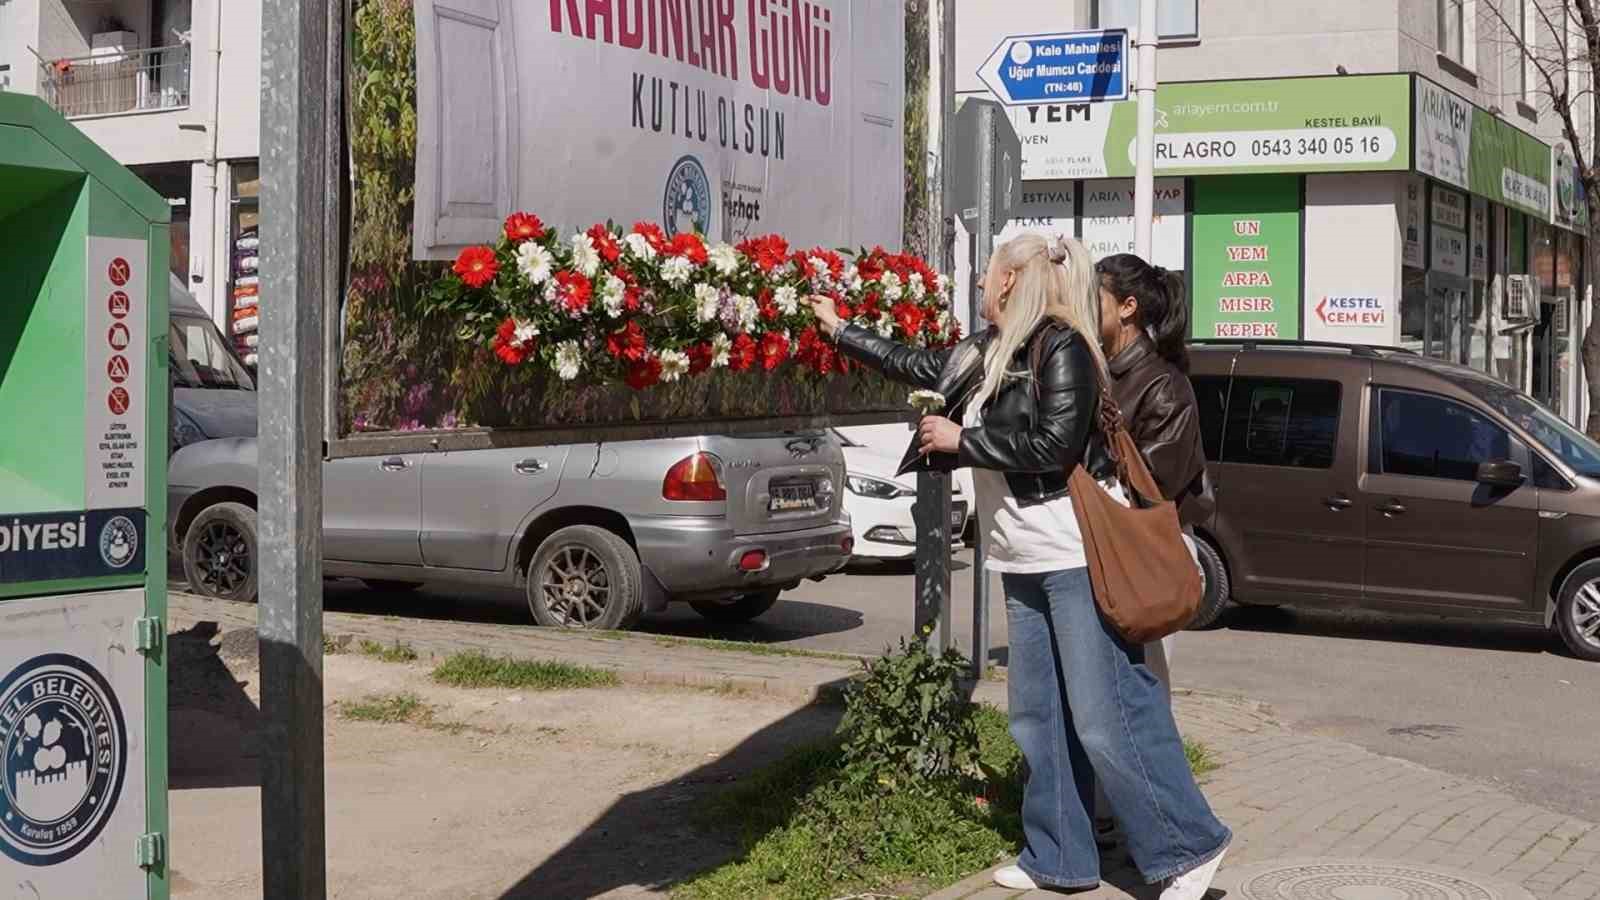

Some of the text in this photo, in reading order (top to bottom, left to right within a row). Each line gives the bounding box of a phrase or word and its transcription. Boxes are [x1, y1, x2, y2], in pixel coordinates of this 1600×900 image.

[748, 0, 831, 106] GÜNÜ
[1065, 41, 1121, 55] Mahallesi
[1009, 60, 1121, 80] Uğur Mumcu Caddesi
[632, 72, 784, 160] KUTLU OLSUN
[1027, 103, 1091, 123] YEM
[1305, 117, 1349, 128] KESTEL
[1183, 140, 1236, 158] AGRO
[1251, 139, 1291, 156] 0543
[1298, 137, 1327, 155] 340
[1333, 137, 1354, 154] 05
[1360, 136, 1380, 153] 16
[1236, 222, 1259, 234] UN
[1228, 247, 1266, 260] YEM
[1224, 272, 1270, 286] ARPA
[1221, 298, 1272, 311] MISIR
[1330, 298, 1381, 308] KESTEL
[1328, 309, 1385, 323] CEM EVİ
[1216, 323, 1276, 337] KEPEK
